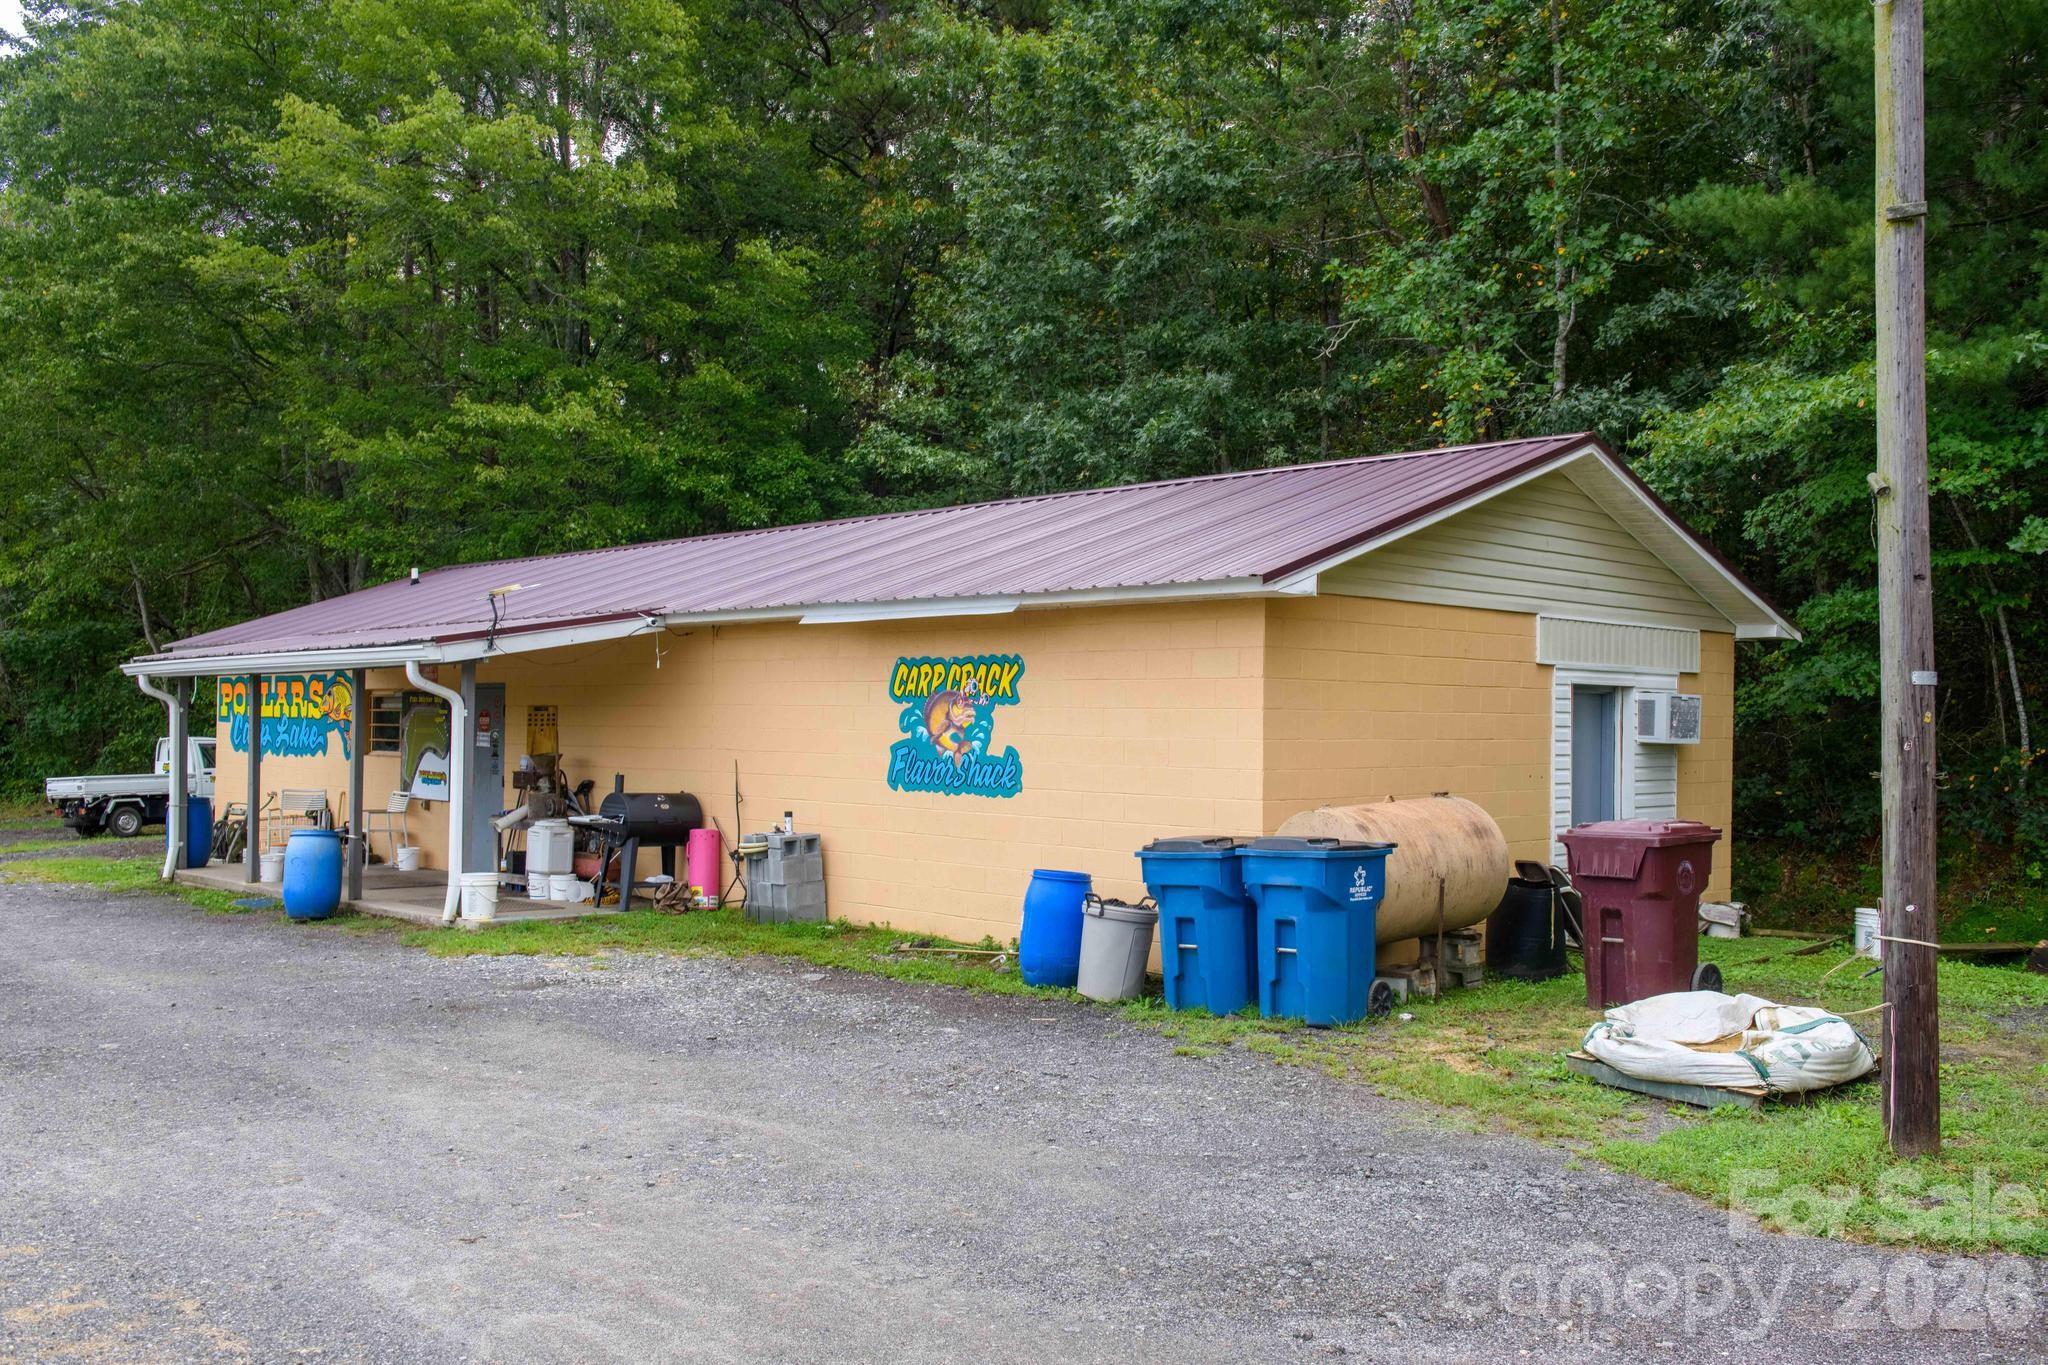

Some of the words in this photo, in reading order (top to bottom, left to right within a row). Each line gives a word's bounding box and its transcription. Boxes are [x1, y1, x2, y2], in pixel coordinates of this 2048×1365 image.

[893, 663, 946, 697] CARP
[946, 662, 1020, 698] CRACK
[220, 680, 325, 719] POLARS
[233, 714, 272, 747] Cap
[276, 715, 325, 749] Lake
[892, 746, 954, 785] Flavor
[953, 752, 1017, 789] Shack
